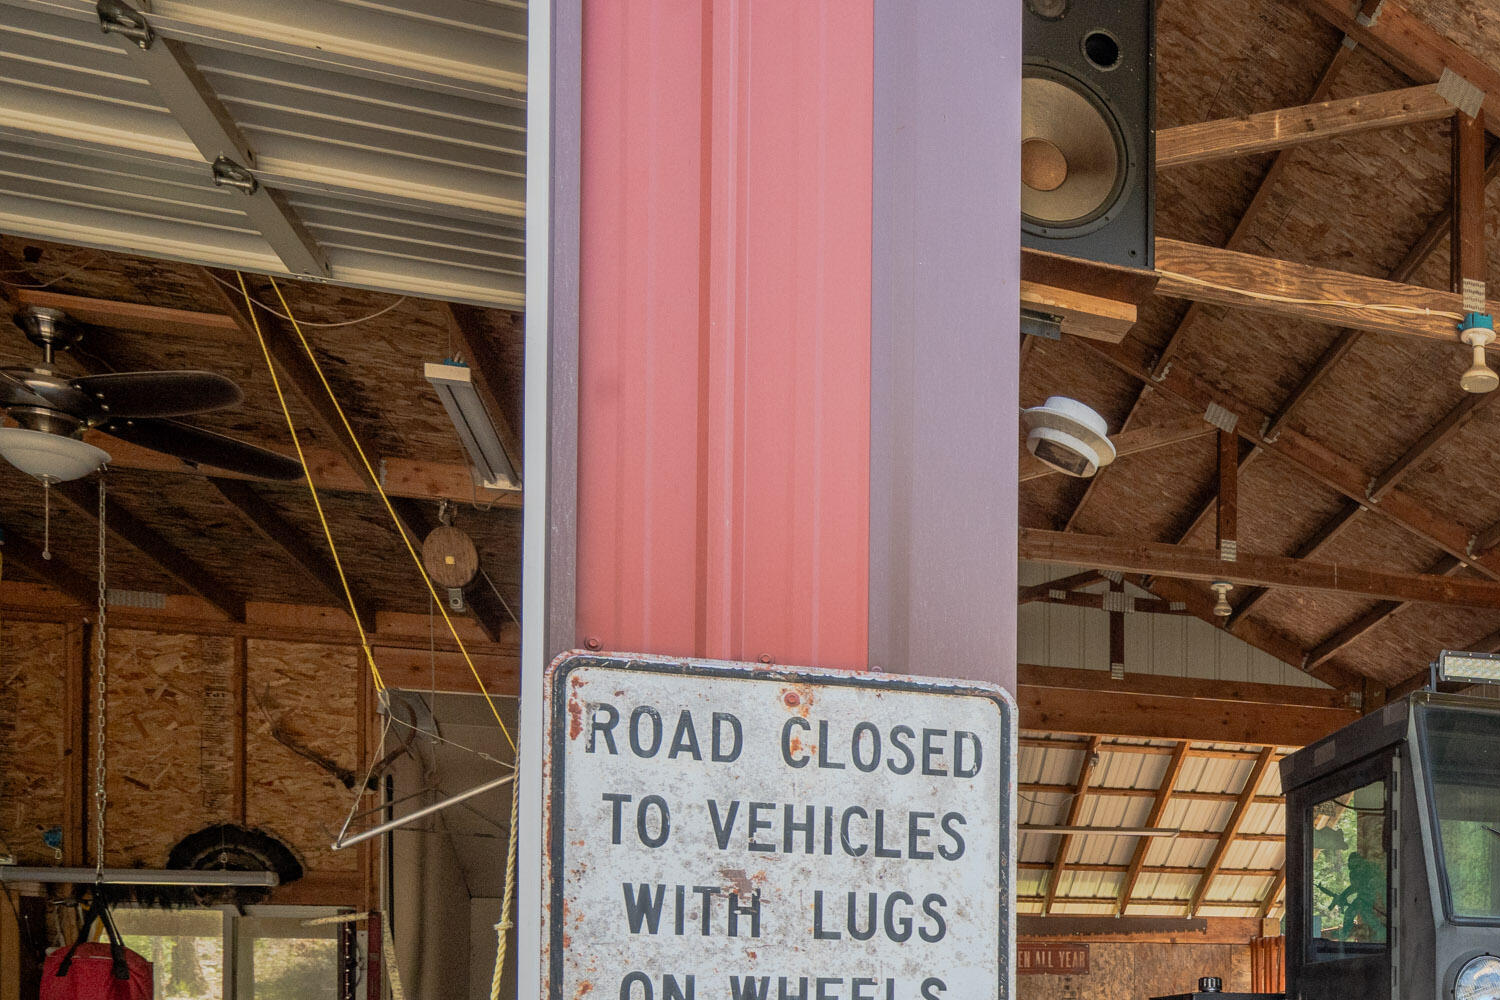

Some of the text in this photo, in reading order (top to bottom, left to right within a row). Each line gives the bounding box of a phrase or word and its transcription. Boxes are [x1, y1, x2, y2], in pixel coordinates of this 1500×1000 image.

[585, 702, 983, 779] ROAD CLOSED
[602, 793, 966, 862] TO VEHICLES
[623, 883, 948, 944] WITH LUGS
[1017, 950, 1031, 968] EN
[1059, 950, 1086, 968] YEAR
